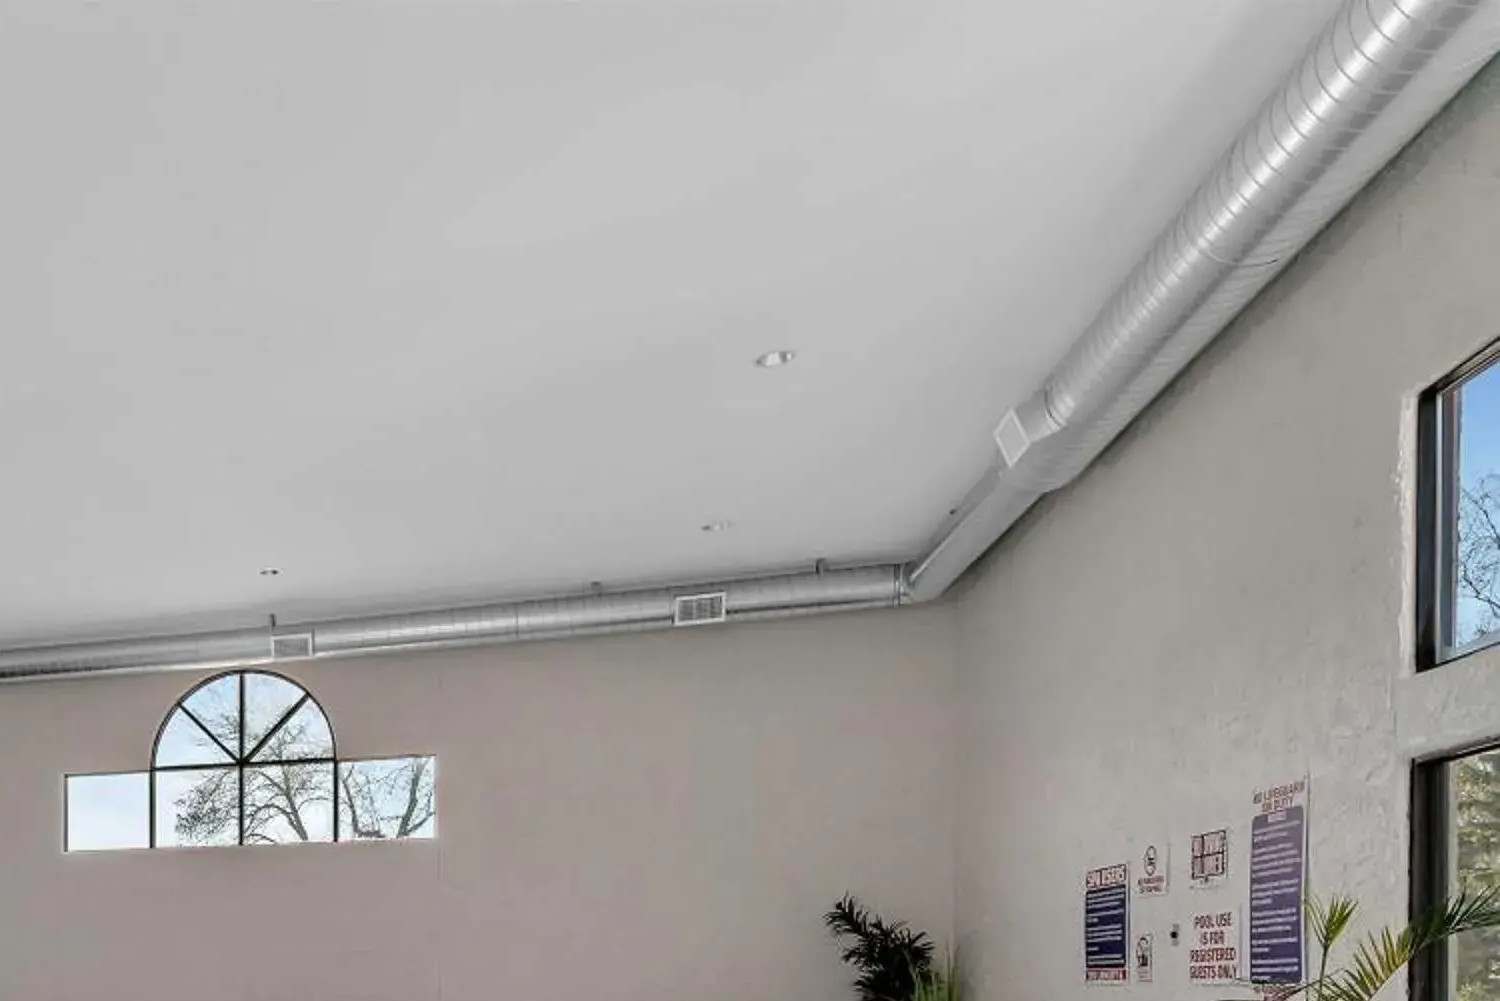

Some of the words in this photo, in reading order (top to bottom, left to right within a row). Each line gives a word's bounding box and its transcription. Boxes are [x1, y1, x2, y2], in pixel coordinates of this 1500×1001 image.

[1194, 914, 1214, 929] POOL
[1216, 911, 1232, 927] USE
[1199, 931, 1208, 945] IS
[1209, 929, 1225, 945] FOR
[1190, 947, 1237, 963] REGISTERED
[1190, 965, 1217, 979] GUESTS
[1218, 964, 1237, 979] ONLY
